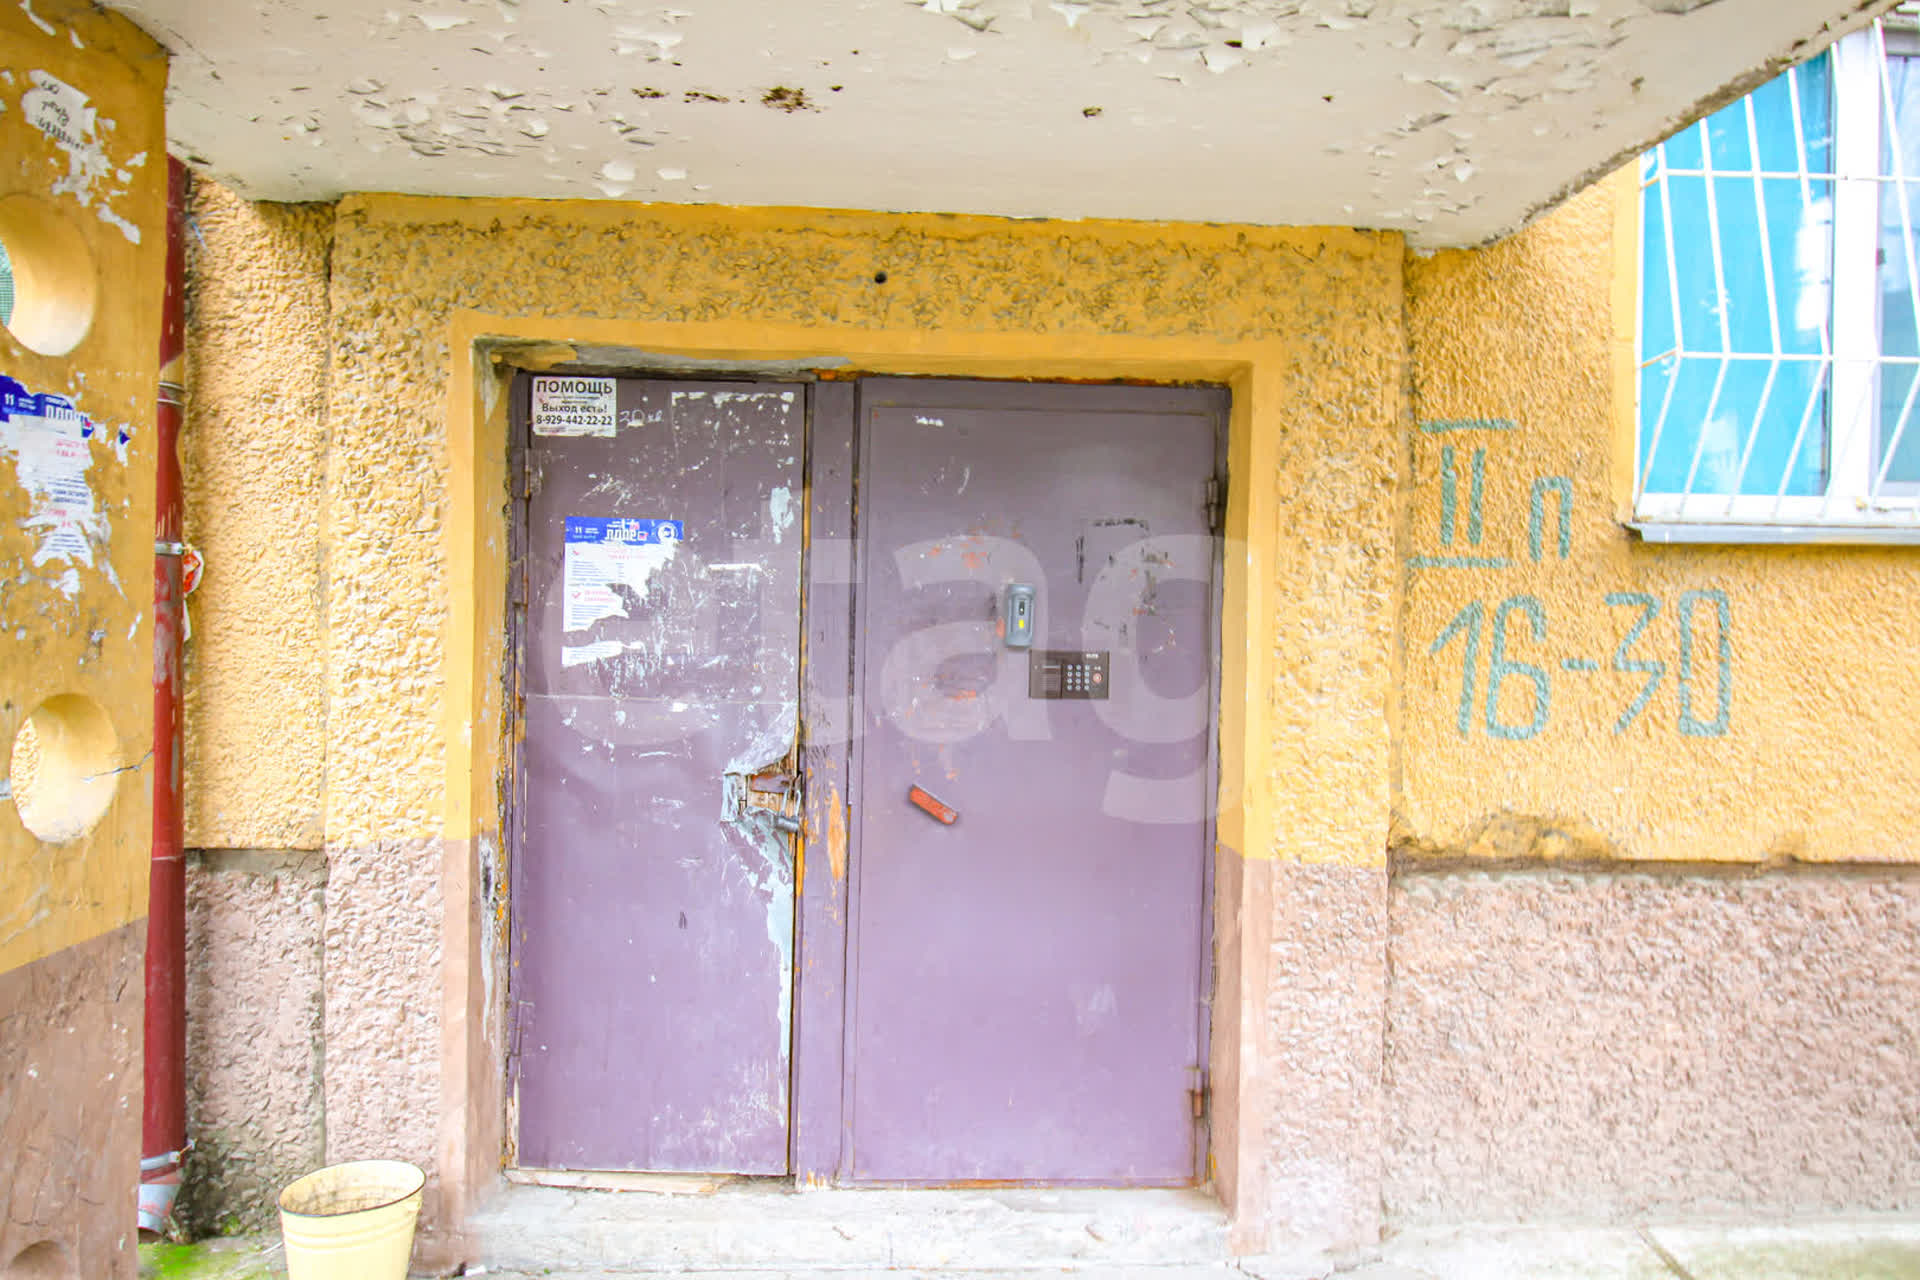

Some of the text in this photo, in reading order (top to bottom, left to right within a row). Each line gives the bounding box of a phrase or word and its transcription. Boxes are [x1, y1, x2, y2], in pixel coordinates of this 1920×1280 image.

[536, 379, 613, 396] ПОМОЩЬ
[542, 403, 578, 414] Выход
[536, 414, 613, 426] 8-929-442-22-22
[1429, 588, 1732, 740] 16-30
